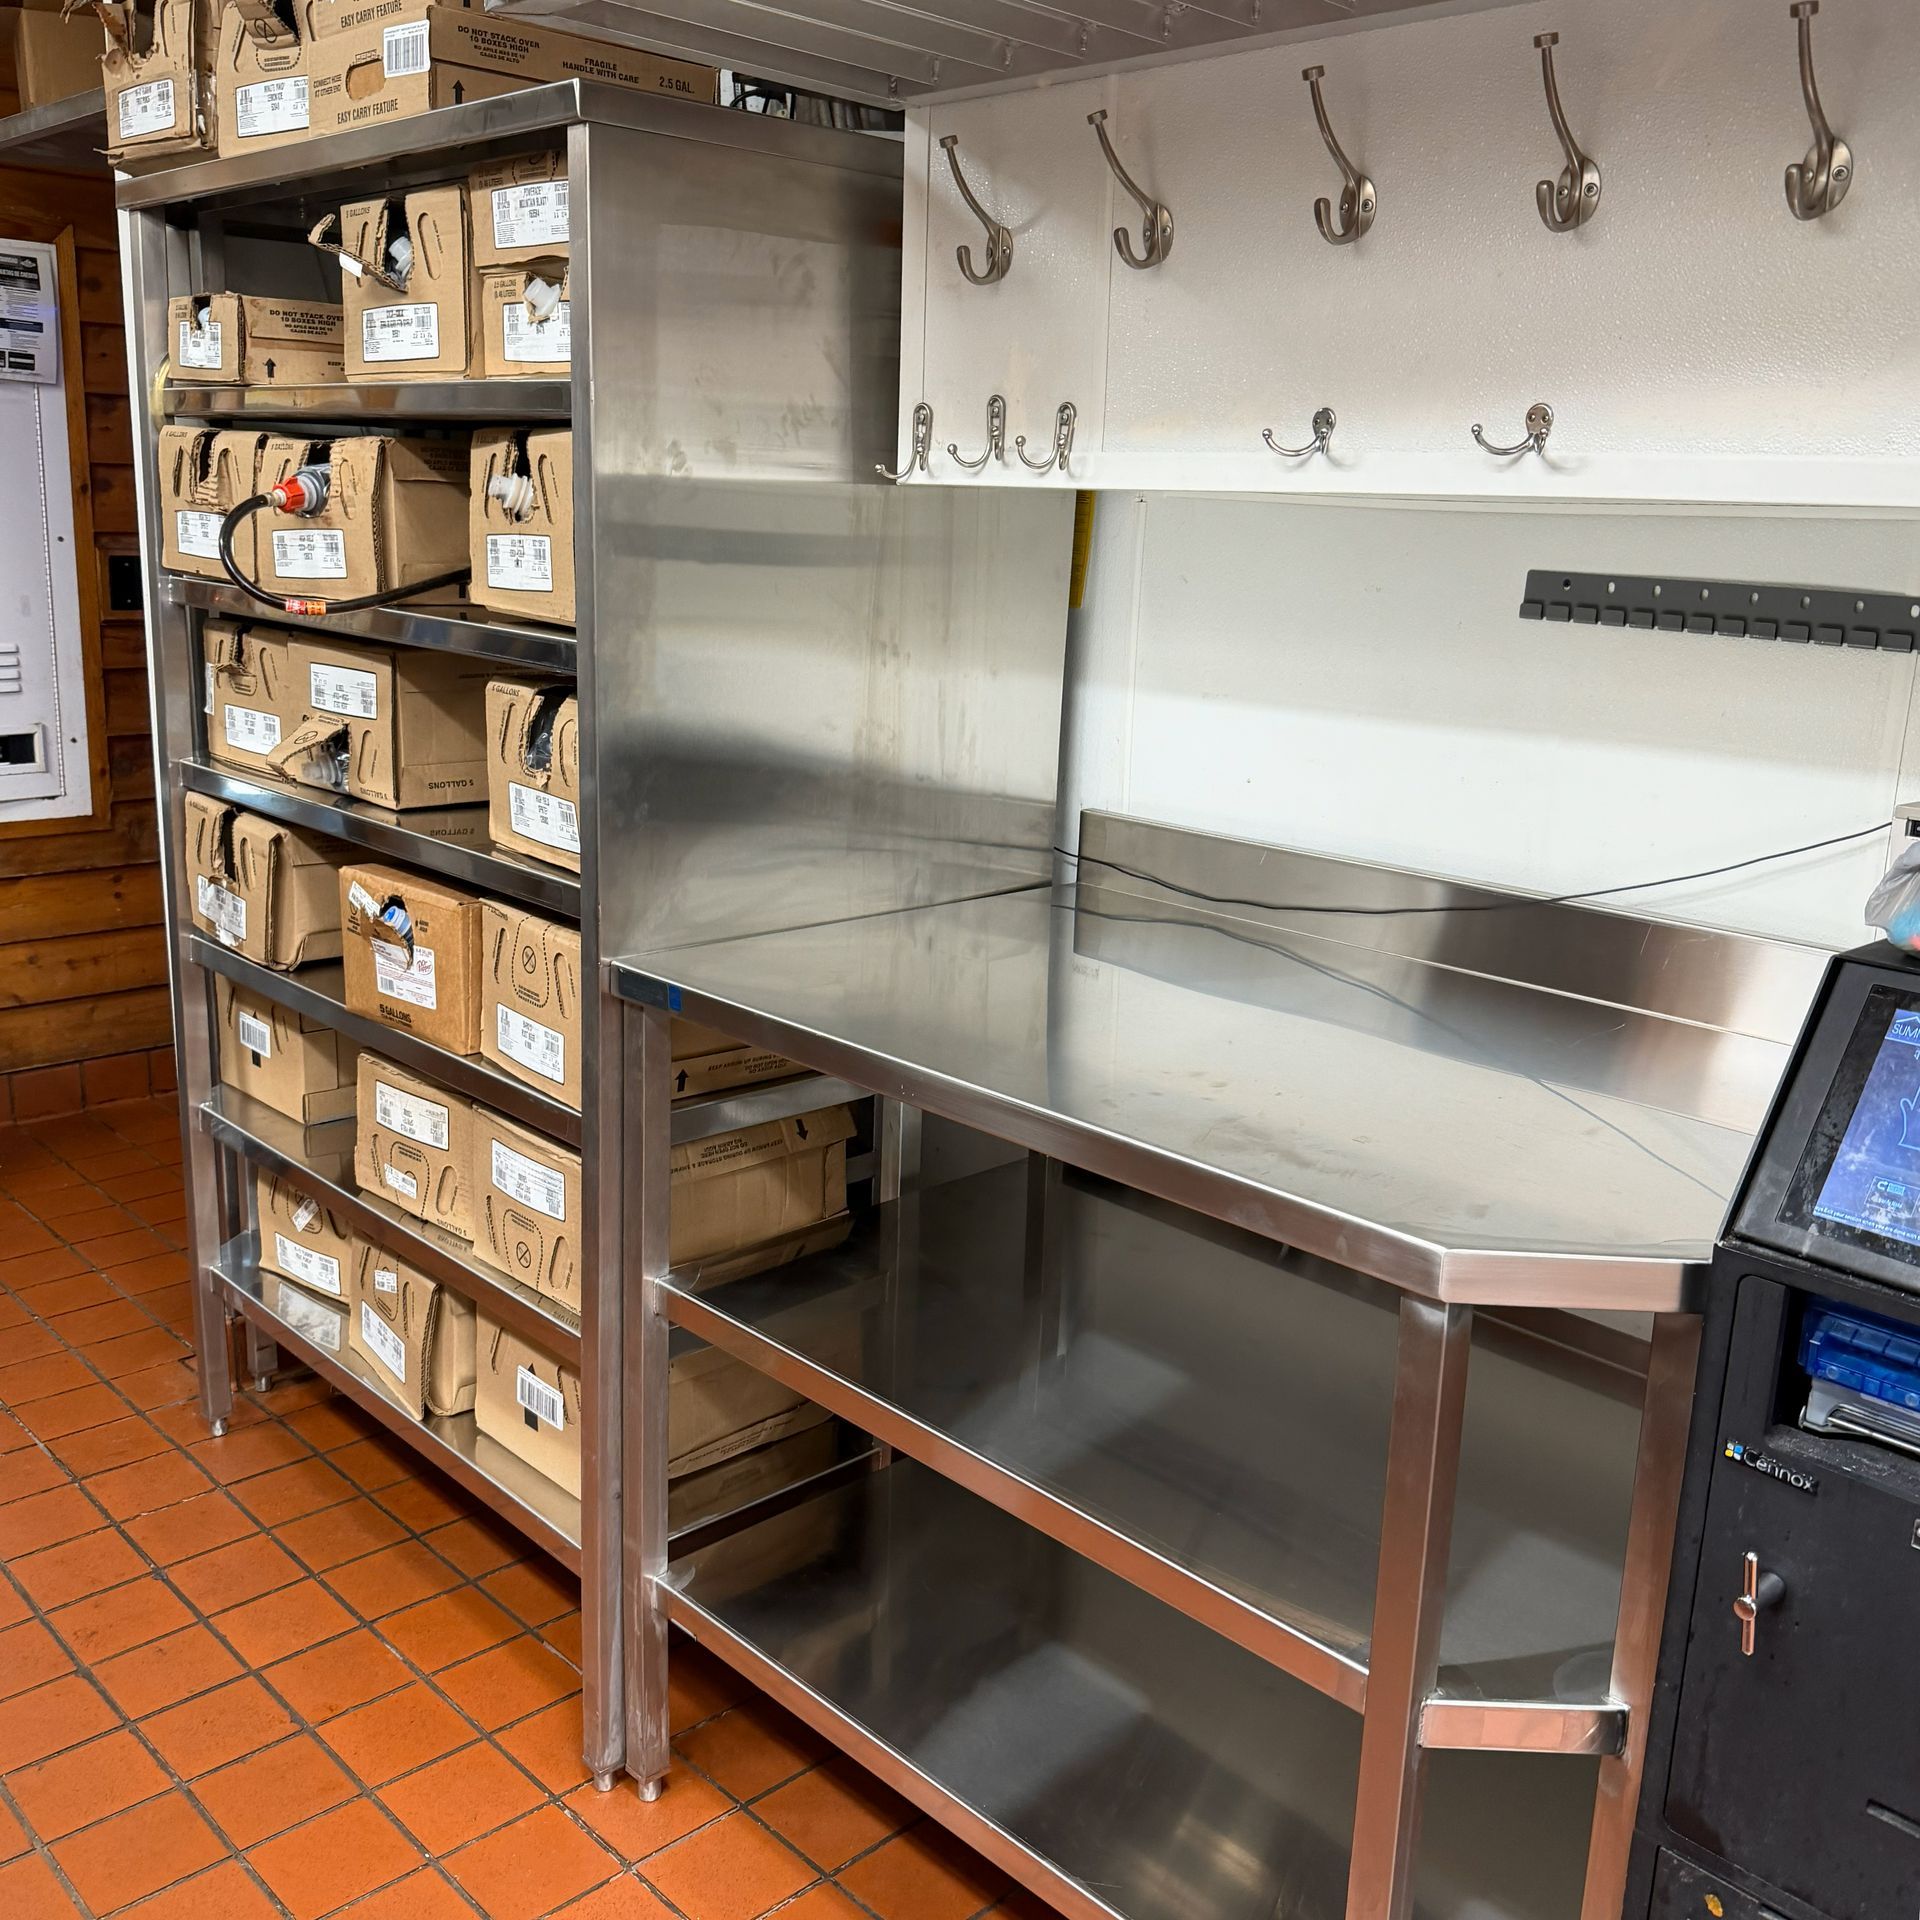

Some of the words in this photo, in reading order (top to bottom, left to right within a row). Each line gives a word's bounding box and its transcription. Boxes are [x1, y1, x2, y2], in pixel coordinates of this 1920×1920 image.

[340, 14, 354, 28] EASY
[356, 7, 375, 24] CARRY
[376, 1, 402, 18] FEATURE
[472, 28, 488, 37] NOT
[490, 32, 517, 44] STACK
[519, 39, 540, 48] OVER
[481, 38, 507, 48] BOXES
[510, 44, 529, 53] HIGH
[562, 61, 595, 75] HANDLE
[596, 68, 616, 79] WITH
[619, 73, 639, 84] CARE
[584, 58, 617, 71] FRAGILE
[659, 76, 673, 89] 2.5
[675, 81, 695, 94] GAL.
[337, 110, 351, 124] EASY
[352, 105, 371, 120] CARRY
[372, 99, 398, 116] FEATURE
[350, 207, 370, 217] GALLONS
[496, 685, 520, 696] GALLONS
[360, 787, 383, 799] GALLONS
[428, 780, 467, 790] GALLONS
[380, 1004, 385, 1014] 5
[386, 1006, 412, 1023] GALLONS
[697, 1156, 722, 1167] STORAGE
[723, 1150, 743, 1161] DURING
[437, 1218, 462, 1235] GALLONS
[1744, 1450, 1813, 1492] Cennox
